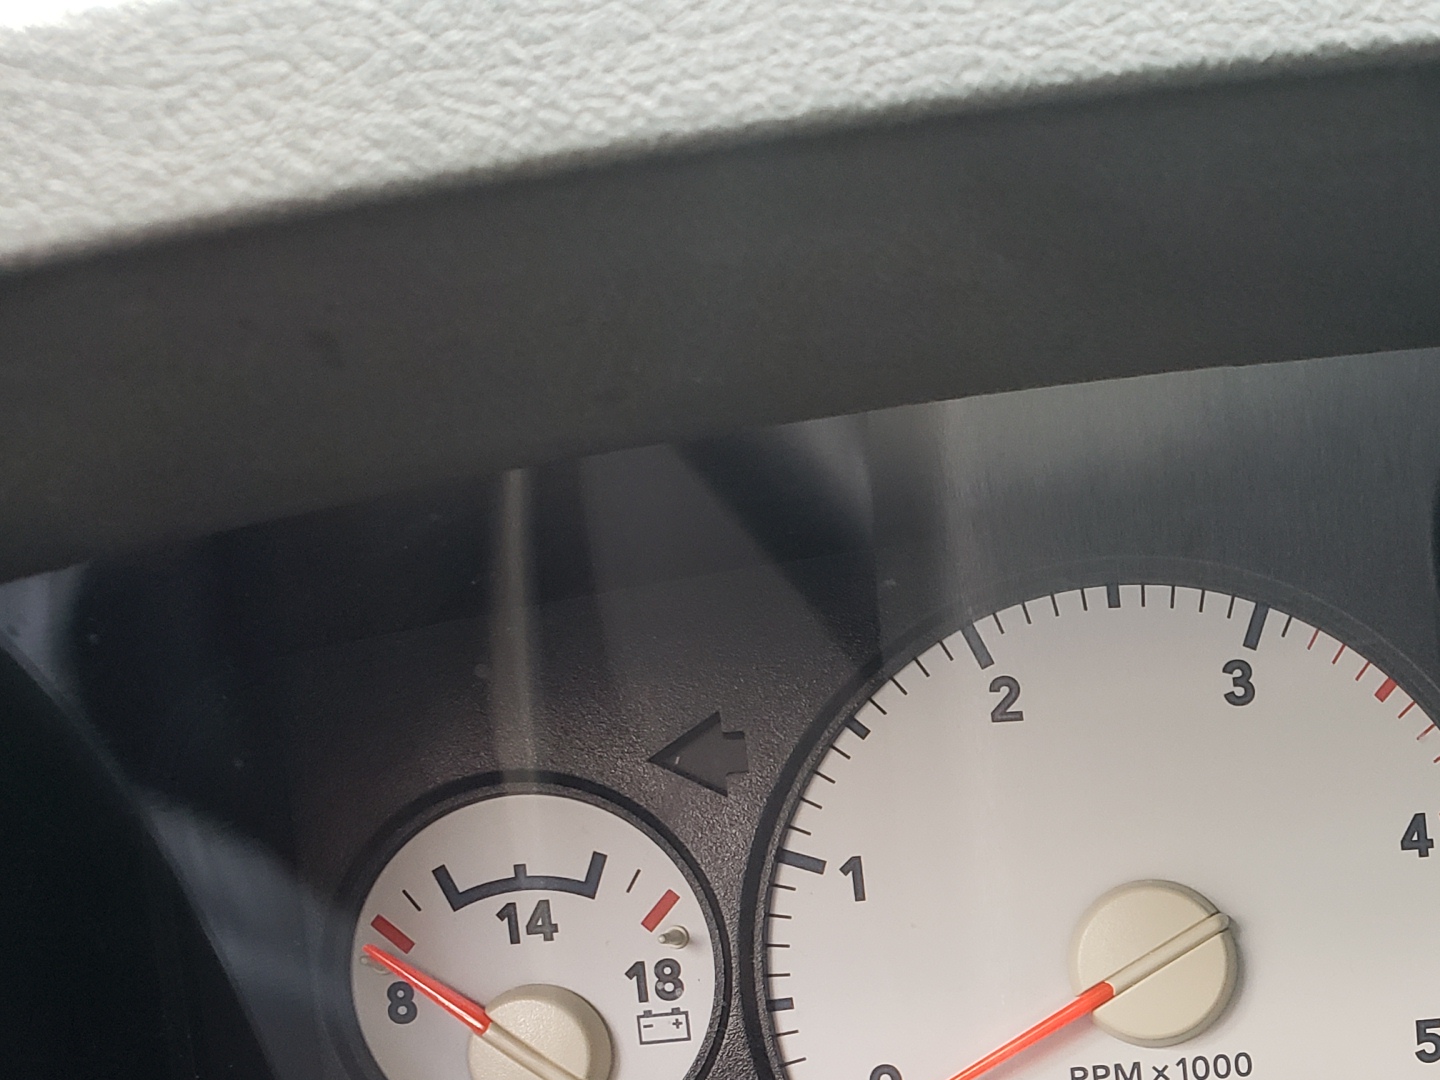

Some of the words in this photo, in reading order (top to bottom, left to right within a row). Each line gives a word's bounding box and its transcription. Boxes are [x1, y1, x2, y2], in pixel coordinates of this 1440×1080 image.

[989, 675, 1024, 723] 2
[1223, 659, 1255, 706] 3
[1400, 812, 1434, 858] 4
[839, 855, 866, 901] 1
[496, 899, 558, 945] 14
[386, 981, 418, 1025] 8
[624, 957, 684, 1003] 18
